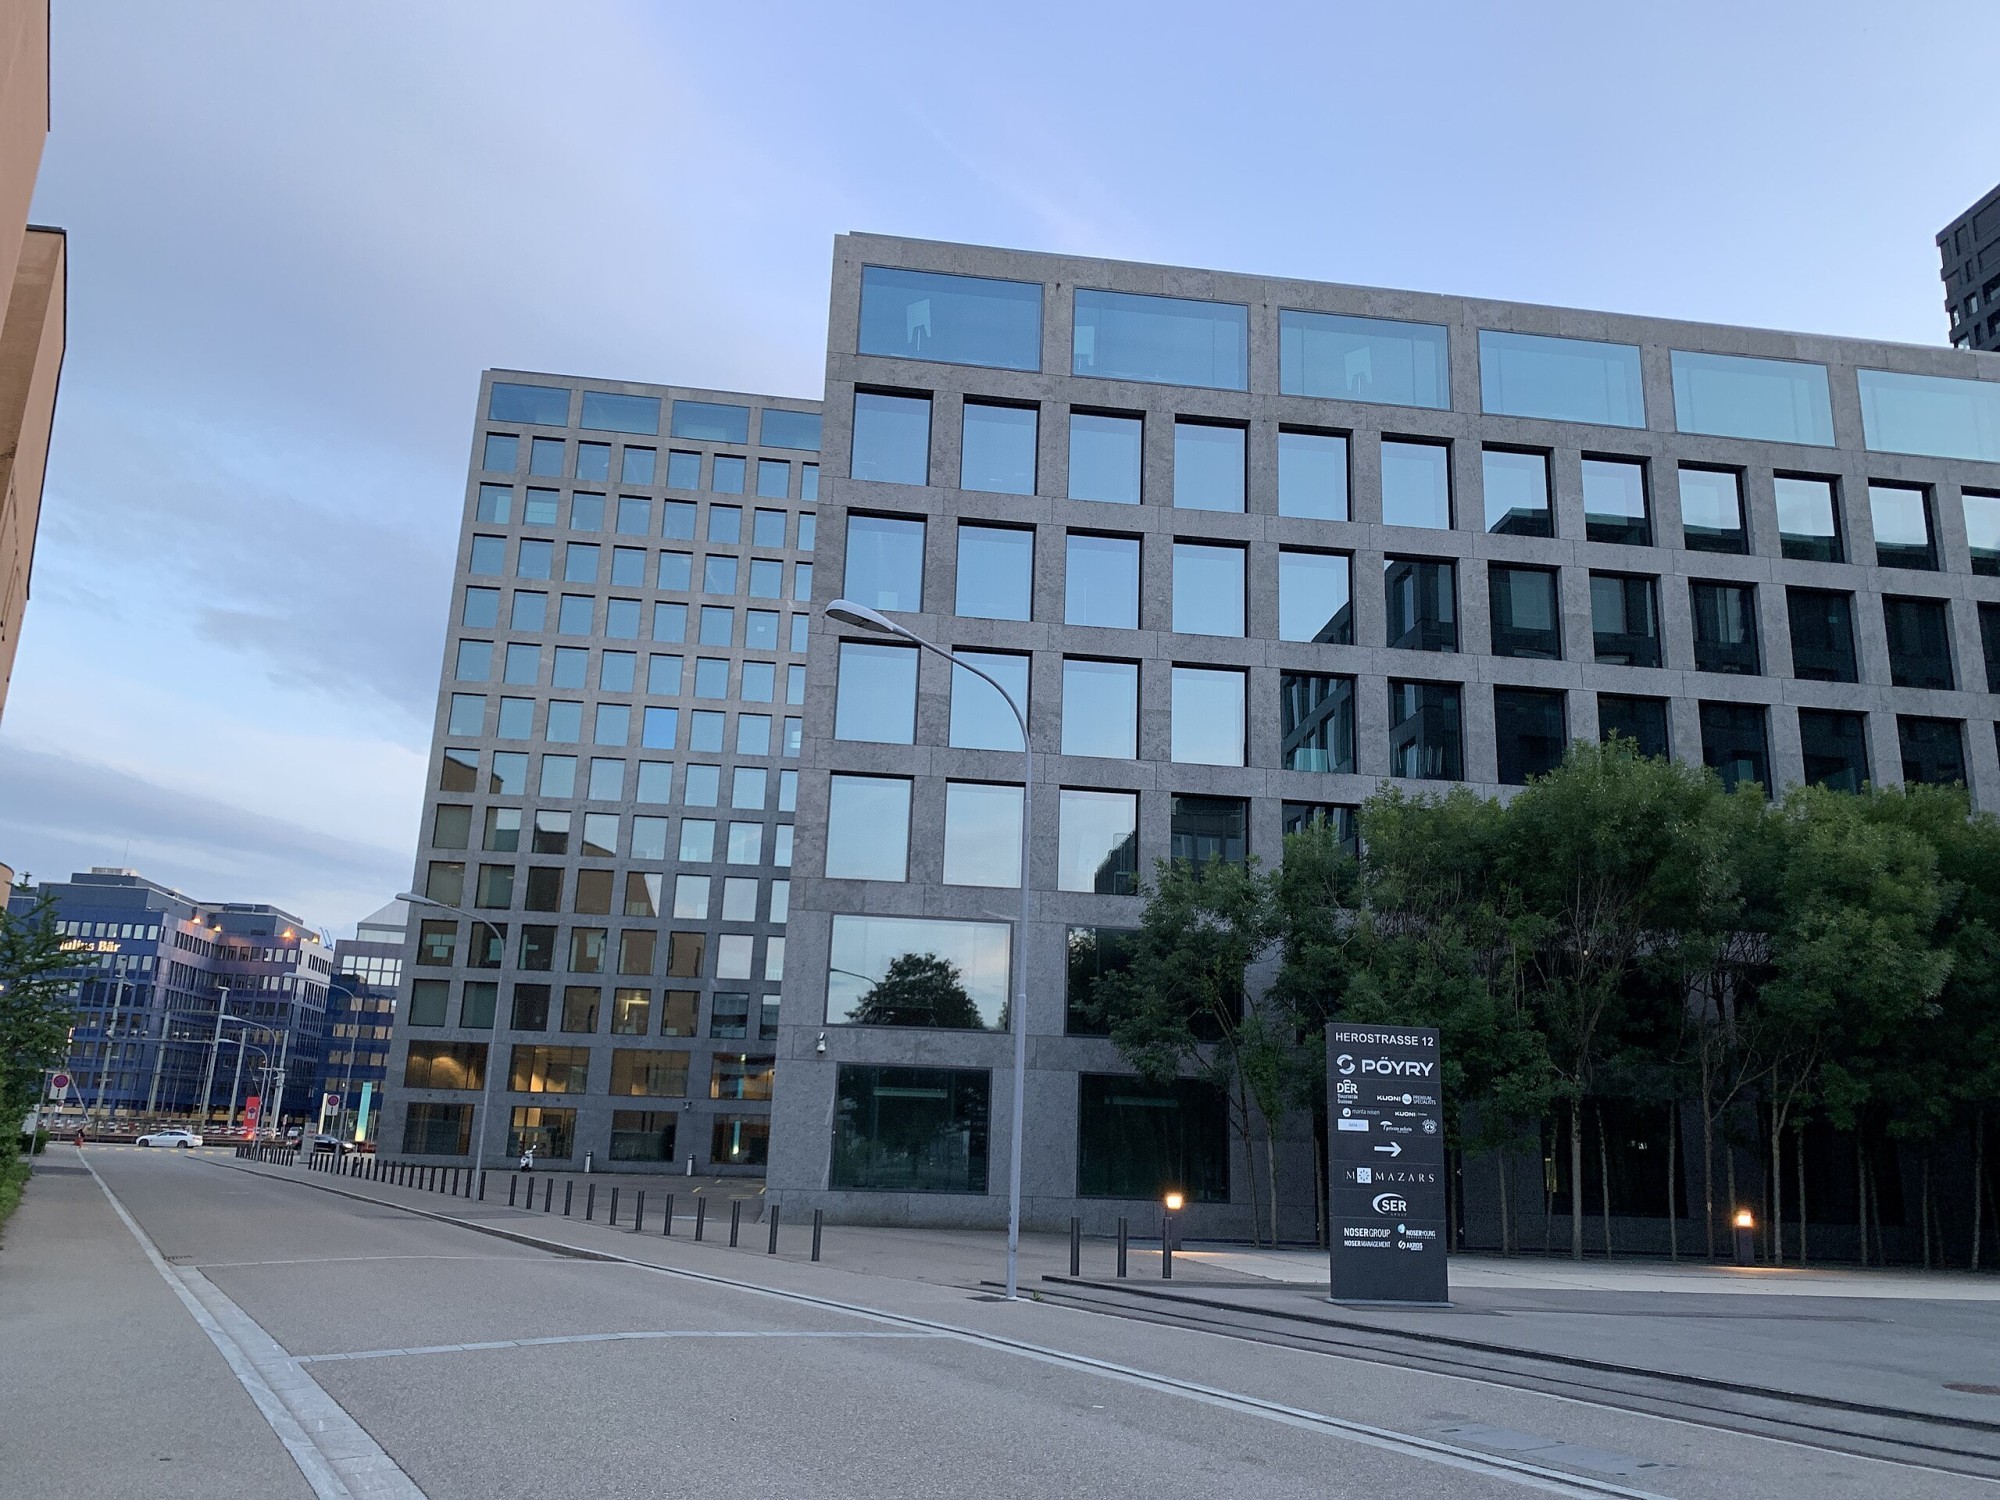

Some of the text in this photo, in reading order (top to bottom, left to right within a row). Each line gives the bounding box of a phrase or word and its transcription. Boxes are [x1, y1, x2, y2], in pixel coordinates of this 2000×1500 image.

[1335, 1032, 1434, 1046] HEROSTRASSE 12
[1361, 1056, 1434, 1076] PÖYRY
[1337, 1082, 1358, 1094] DER
[1376, 1094, 1401, 1102] KUONI
[1375, 1171, 1435, 1183] MAZARS
[1382, 1200, 1407, 1212] SER
